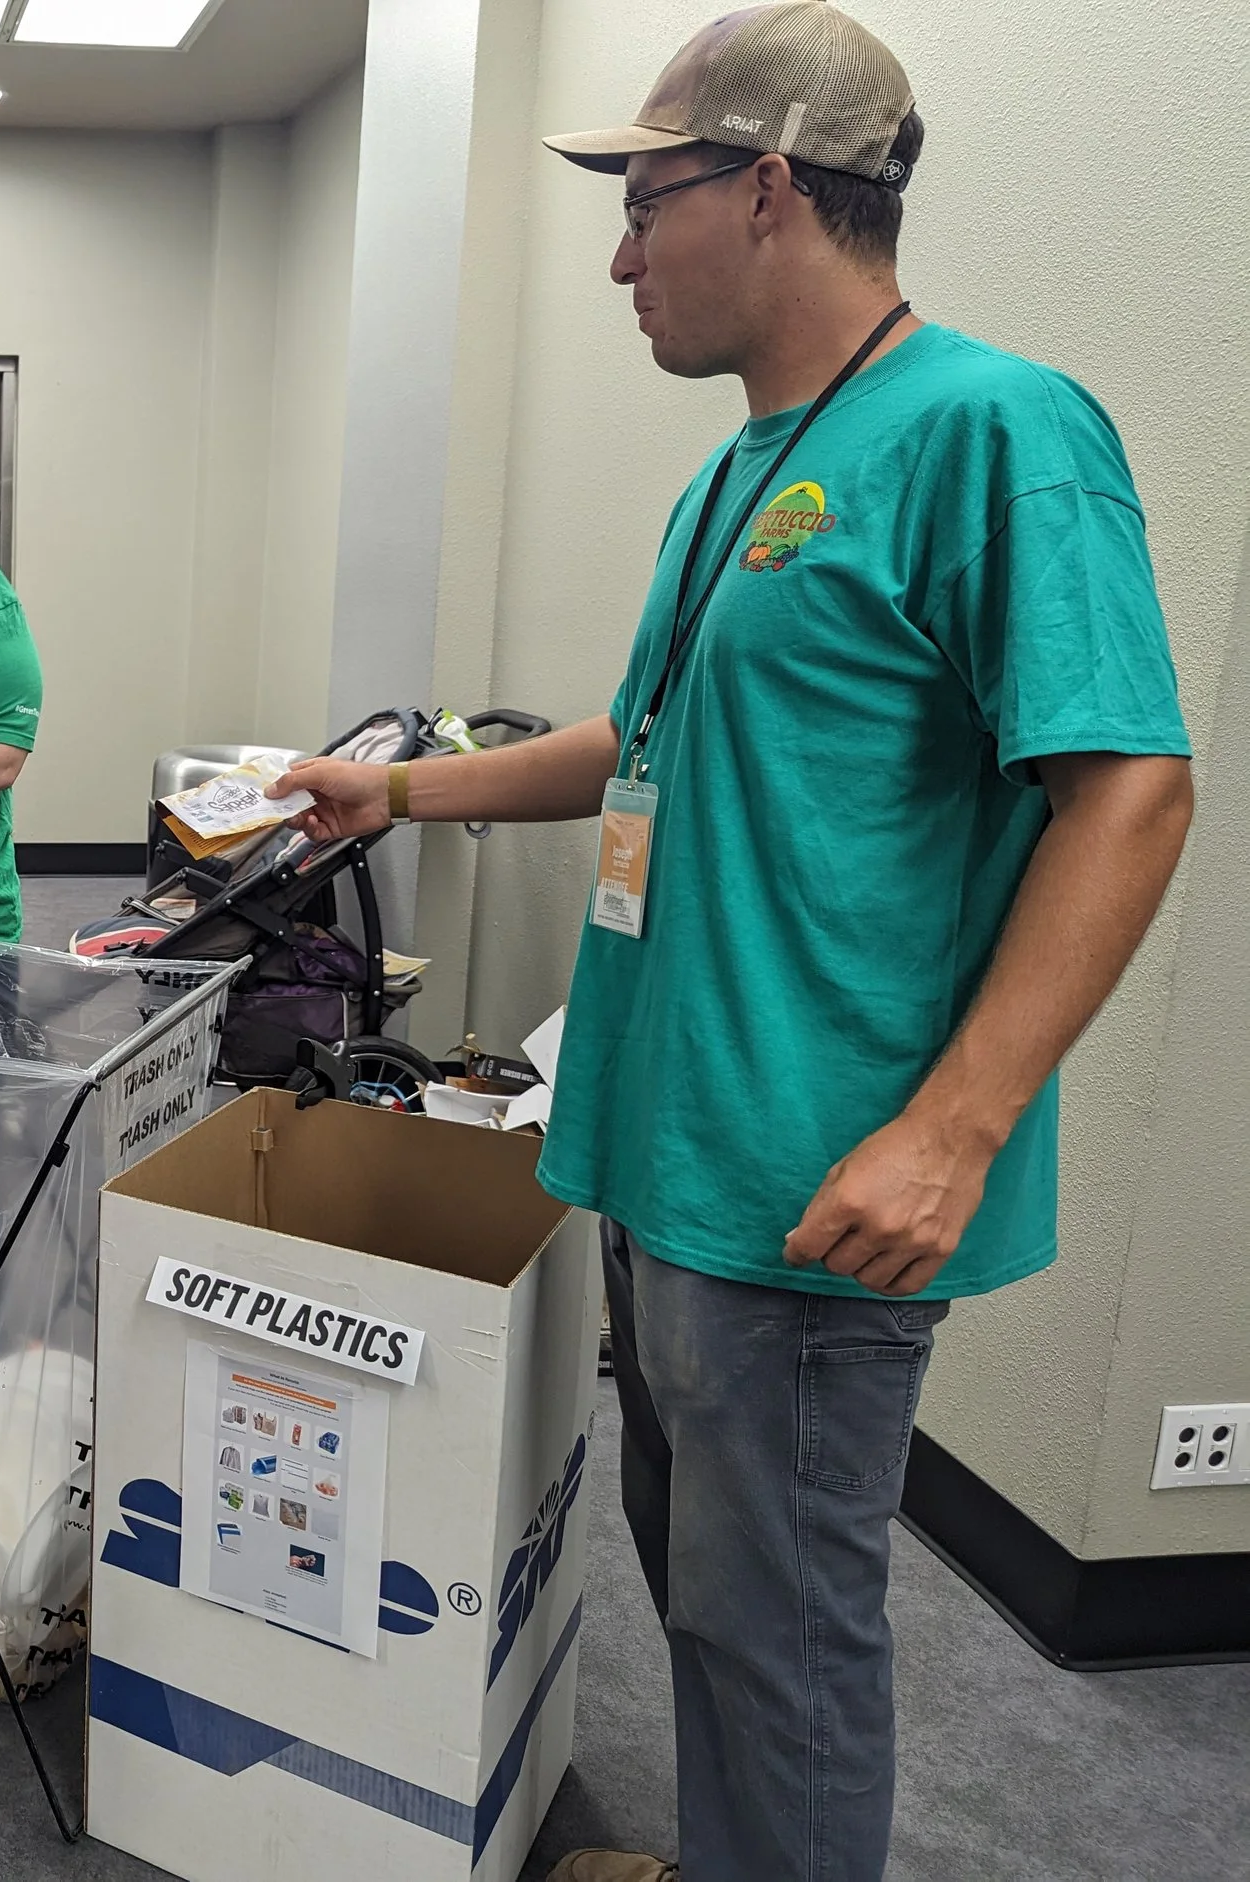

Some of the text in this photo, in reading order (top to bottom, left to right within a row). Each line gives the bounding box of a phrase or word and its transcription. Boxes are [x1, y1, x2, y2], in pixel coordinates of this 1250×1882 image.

[720, 114, 764, 133] ARIAT
[760, 528, 792, 539] FARMS
[123, 1031, 199, 1100] TRASH ONLY
[118, 1084, 197, 1158] TRASH ONLY
[165, 1268, 409, 1369] SOFT PLASTICS
